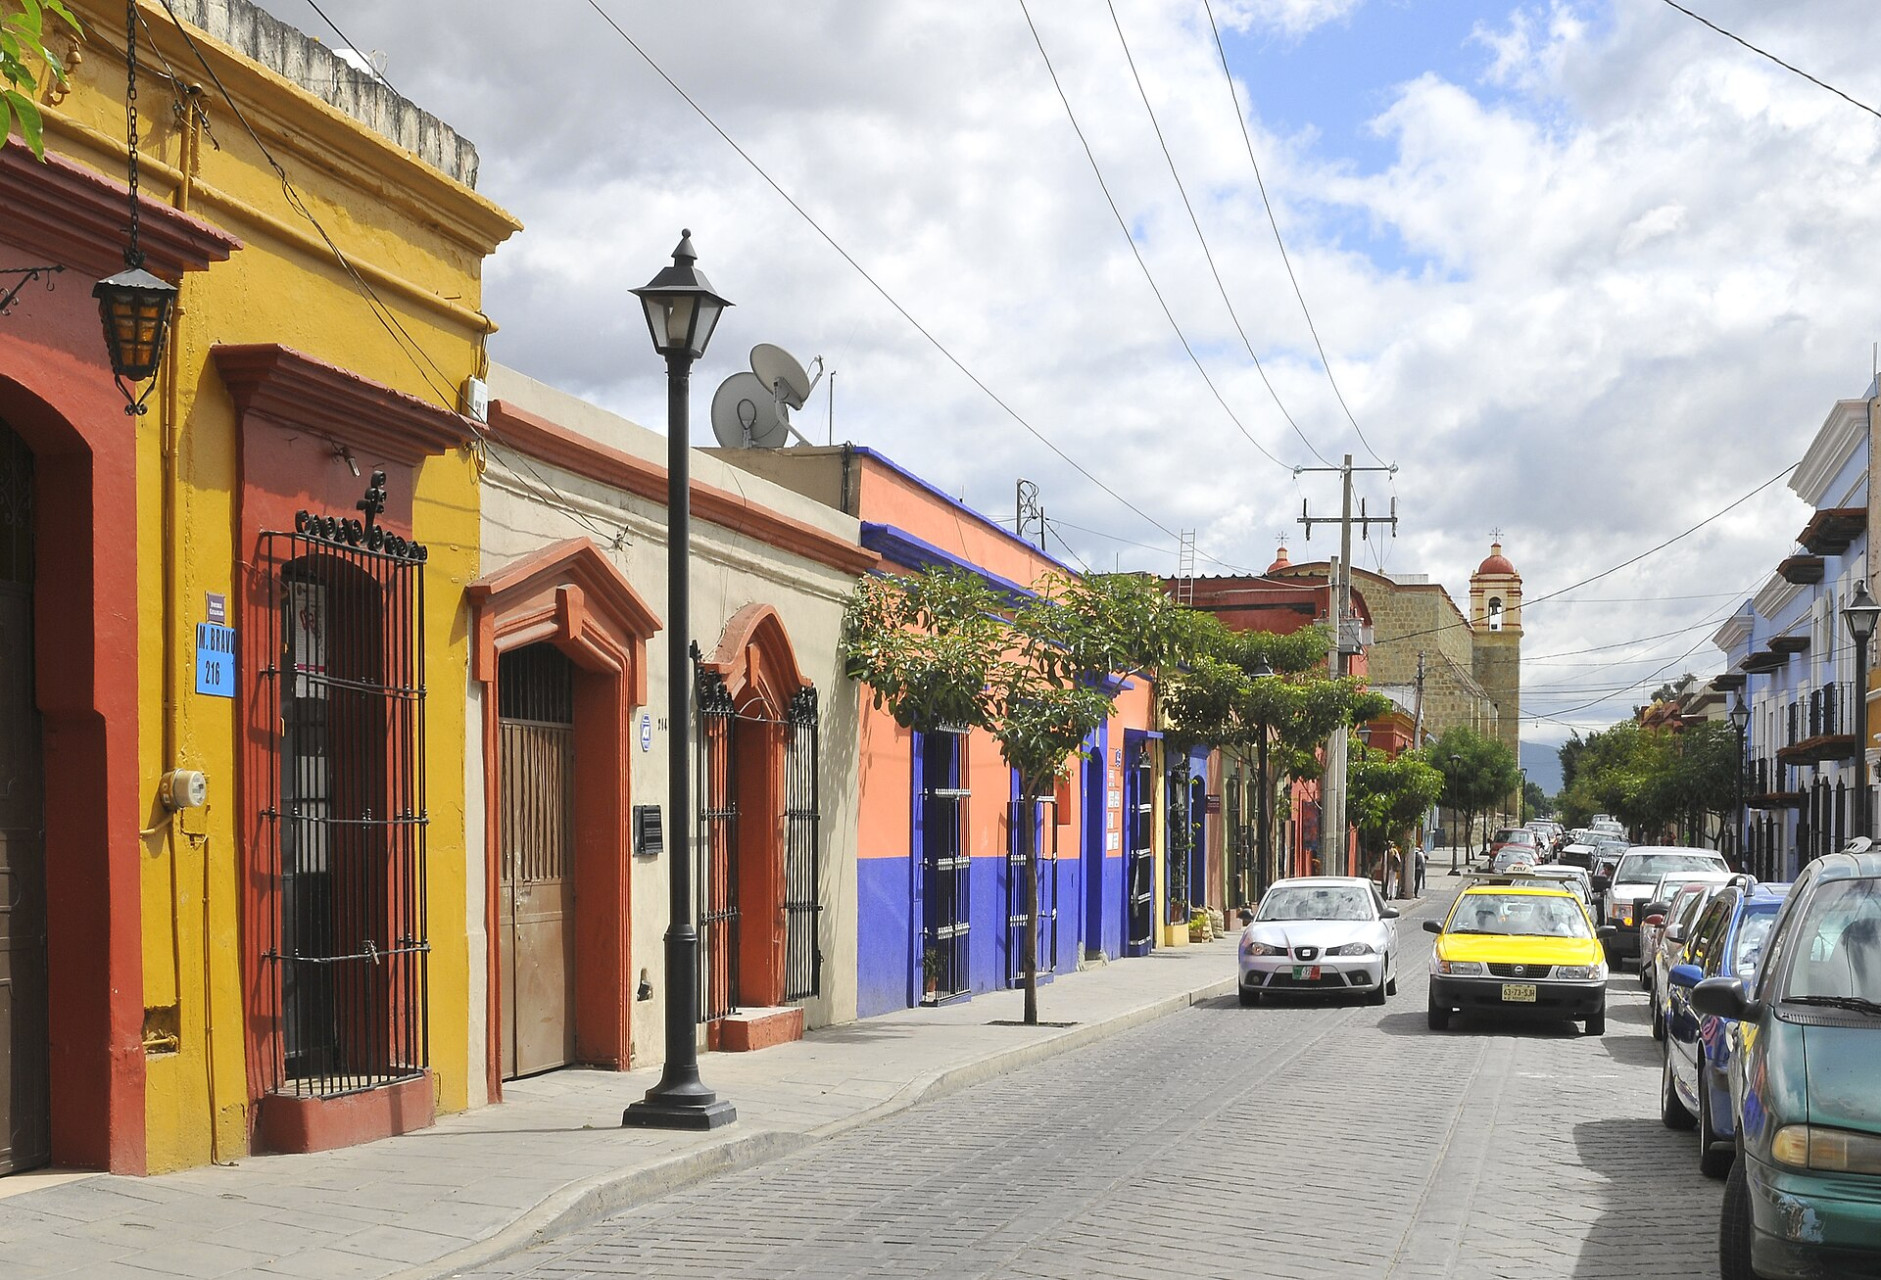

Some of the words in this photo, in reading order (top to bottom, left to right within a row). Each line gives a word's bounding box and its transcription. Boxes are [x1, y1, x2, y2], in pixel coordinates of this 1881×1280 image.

[199, 626, 208, 650] M.
[210, 627, 236, 655] BRAVO
[205, 660, 220, 686] 216
